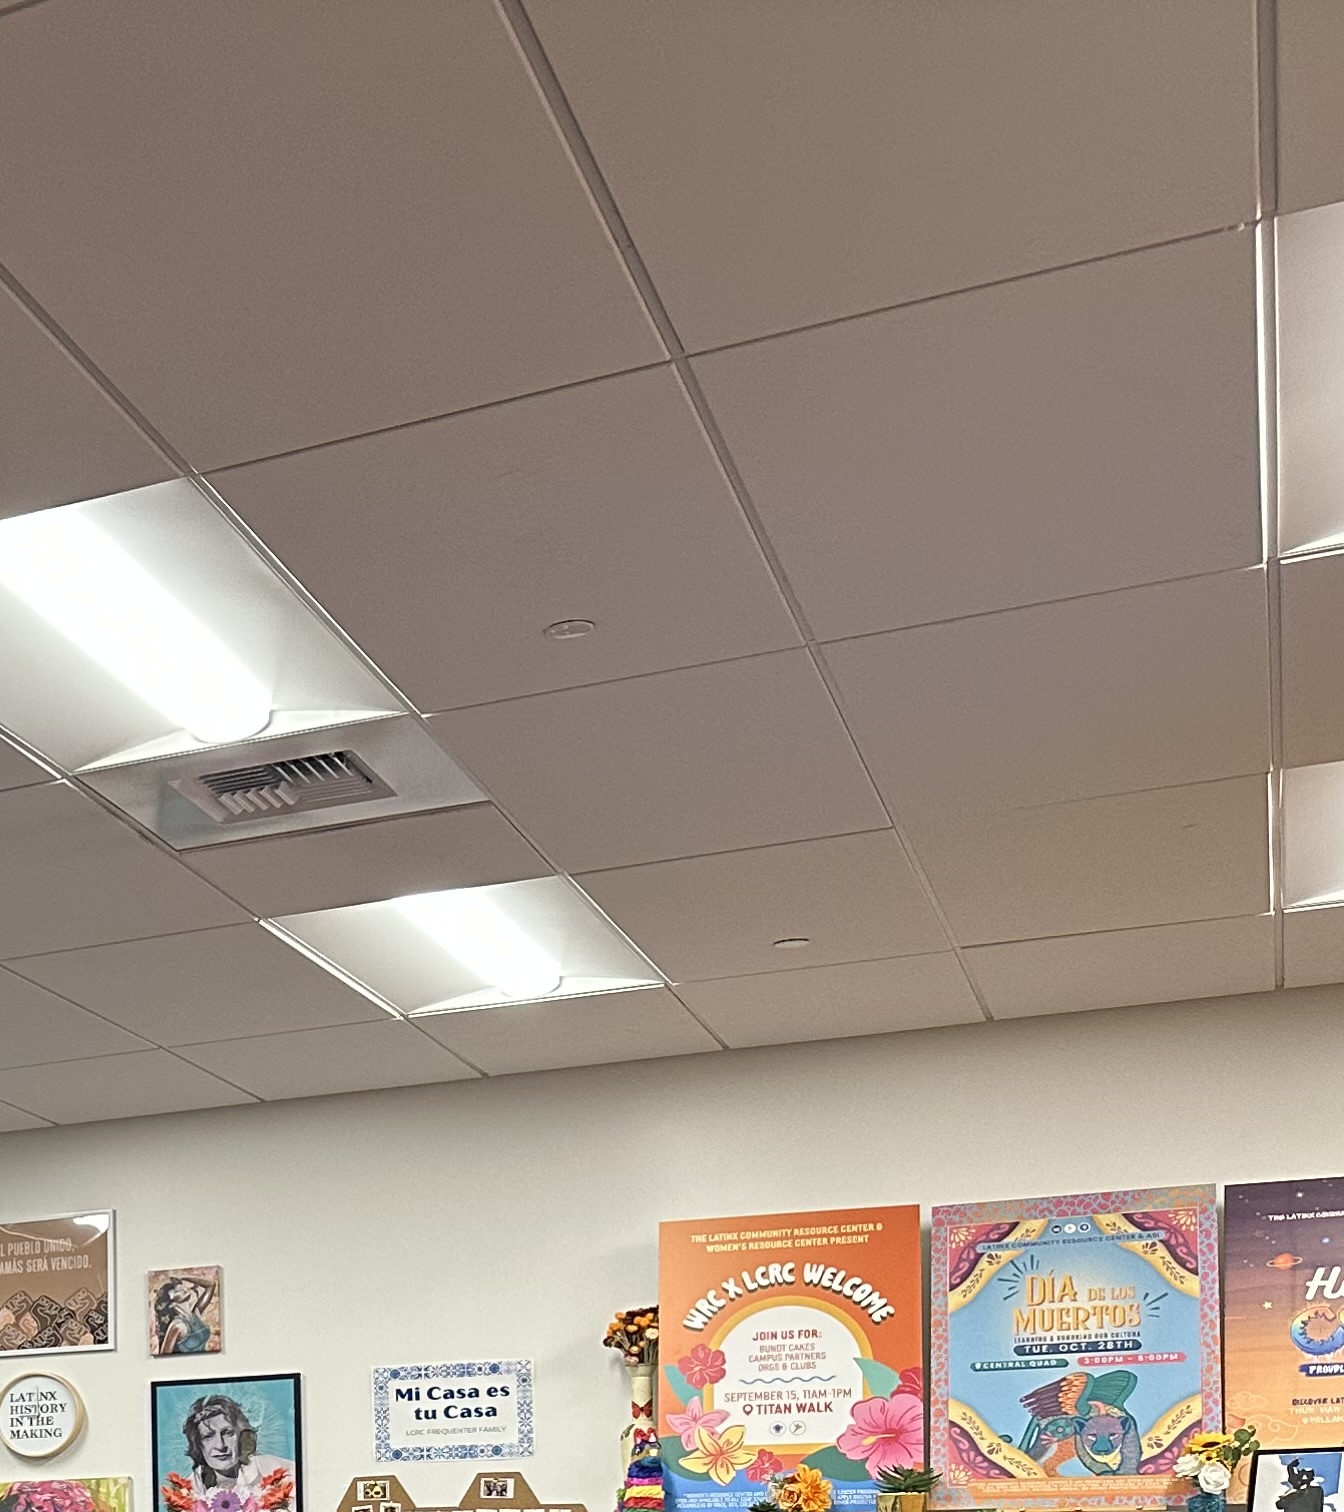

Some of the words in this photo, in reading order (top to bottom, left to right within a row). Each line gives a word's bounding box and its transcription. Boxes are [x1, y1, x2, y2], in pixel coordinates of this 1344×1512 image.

[691, 1234, 707, 1243] THE
[709, 1232, 738, 1242] LATINX
[740, 1228, 792, 1240] COMMUNITY
[793, 1226, 838, 1237] RESOURCE
[840, 1223, 875, 1233] CENTER
[7, 1240, 41, 1256] PUEBLO
[706, 1242, 746, 1253] WOMEN'S
[748, 1240, 793, 1251] RESOURCE
[794, 1237, 828, 1248] CENTER
[830, 1234, 869, 1245] PRESENT
[1012, 1239, 1060, 1249] COMMUNITY
[1062, 1236, 1103, 1245] RESOURCE
[1105, 1233, 1136, 1242] CENTER
[26, 1255, 49, 1273] SERÁ
[50, 1254, 92, 1271] VENCIDO.
[1025, 1270, 1078, 1307] DÍA
[1087, 1288, 1106, 1301] DE
[1110, 1285, 1136, 1301] LOS
[682, 1289, 727, 1332] WRC
[741, 1261, 796, 1293] LCRC
[802, 1262, 896, 1326] WELCOME
[1013, 1303, 1142, 1336] MUERTOS
[752, 1331, 778, 1341] JOIN
[781, 1330, 795, 1340] US
[788, 1343, 815, 1352] CAKES
[1023, 1344, 1053, 1354] TUE.
[1058, 1342, 1092, 1352] OCT.
[1097, 1340, 1133, 1351] 28TH
[748, 1354, 783, 1363] CAMPUS
[785, 1351, 826, 1361] PARTNERS
[983, 1360, 1026, 1369] CENTRAL
[1029, 1359, 1057, 1367] QUAD
[790, 1361, 817, 1370] CLUBS
[9, 1391, 58, 1403] LATNX
[395, 1386, 421, 1402] Mi
[426, 1386, 480, 1400] Casa
[486, 1385, 510, 1397] es
[724, 1390, 784, 1403] SEPTEMBER
[786, 1390, 800, 1402] 15,
[802, 1388, 852, 1400] 11AM-1PM
[9, 1402, 68, 1415] HISTORY
[414, 1407, 437, 1420] tu
[443, 1405, 498, 1419] Casa
[756, 1403, 792, 1415] TITAN
[795, 1401, 833, 1414] WALK
[9, 1417, 23, 1427] IN
[26, 1415, 54, 1427] THE
[9, 1428, 63, 1440] MAKING
